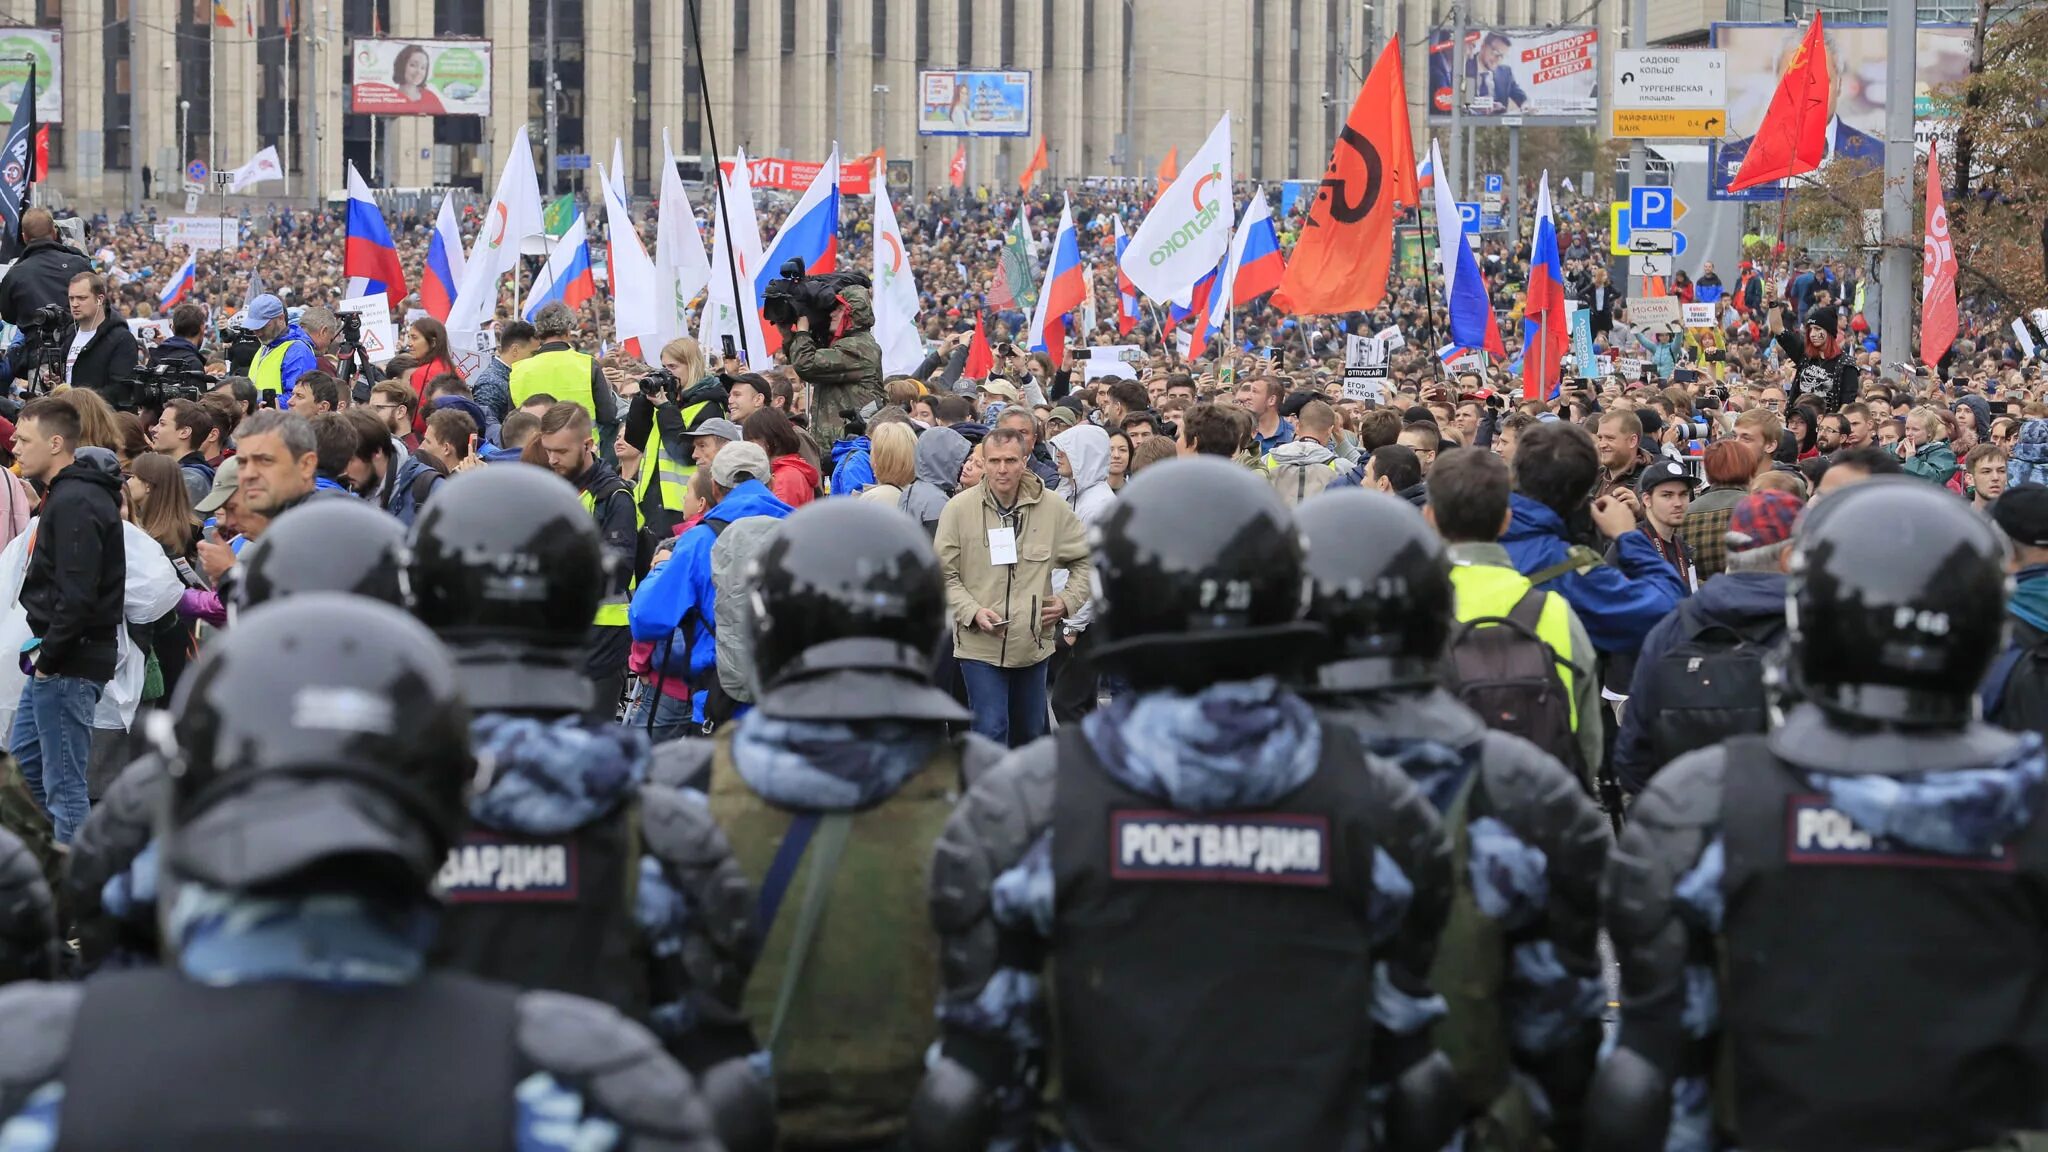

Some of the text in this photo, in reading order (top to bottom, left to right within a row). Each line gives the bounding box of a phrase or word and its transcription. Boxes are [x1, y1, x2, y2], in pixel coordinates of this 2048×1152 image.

[1539, 35, 1585, 57] ПЕРЕКУР
[1558, 49, 1581, 64] ШАГ
[1547, 61, 1586, 80] УСПЕХУ
[1490, 177, 1500, 190] P
[1459, 205, 1476, 222] P
[1641, 191, 1665, 225] P
[1633, 305, 1669, 314] МОСКВА
[1347, 389, 1375, 398] ЖУКОВ
[1121, 822, 1321, 874] РОСГВАРДИЯ
